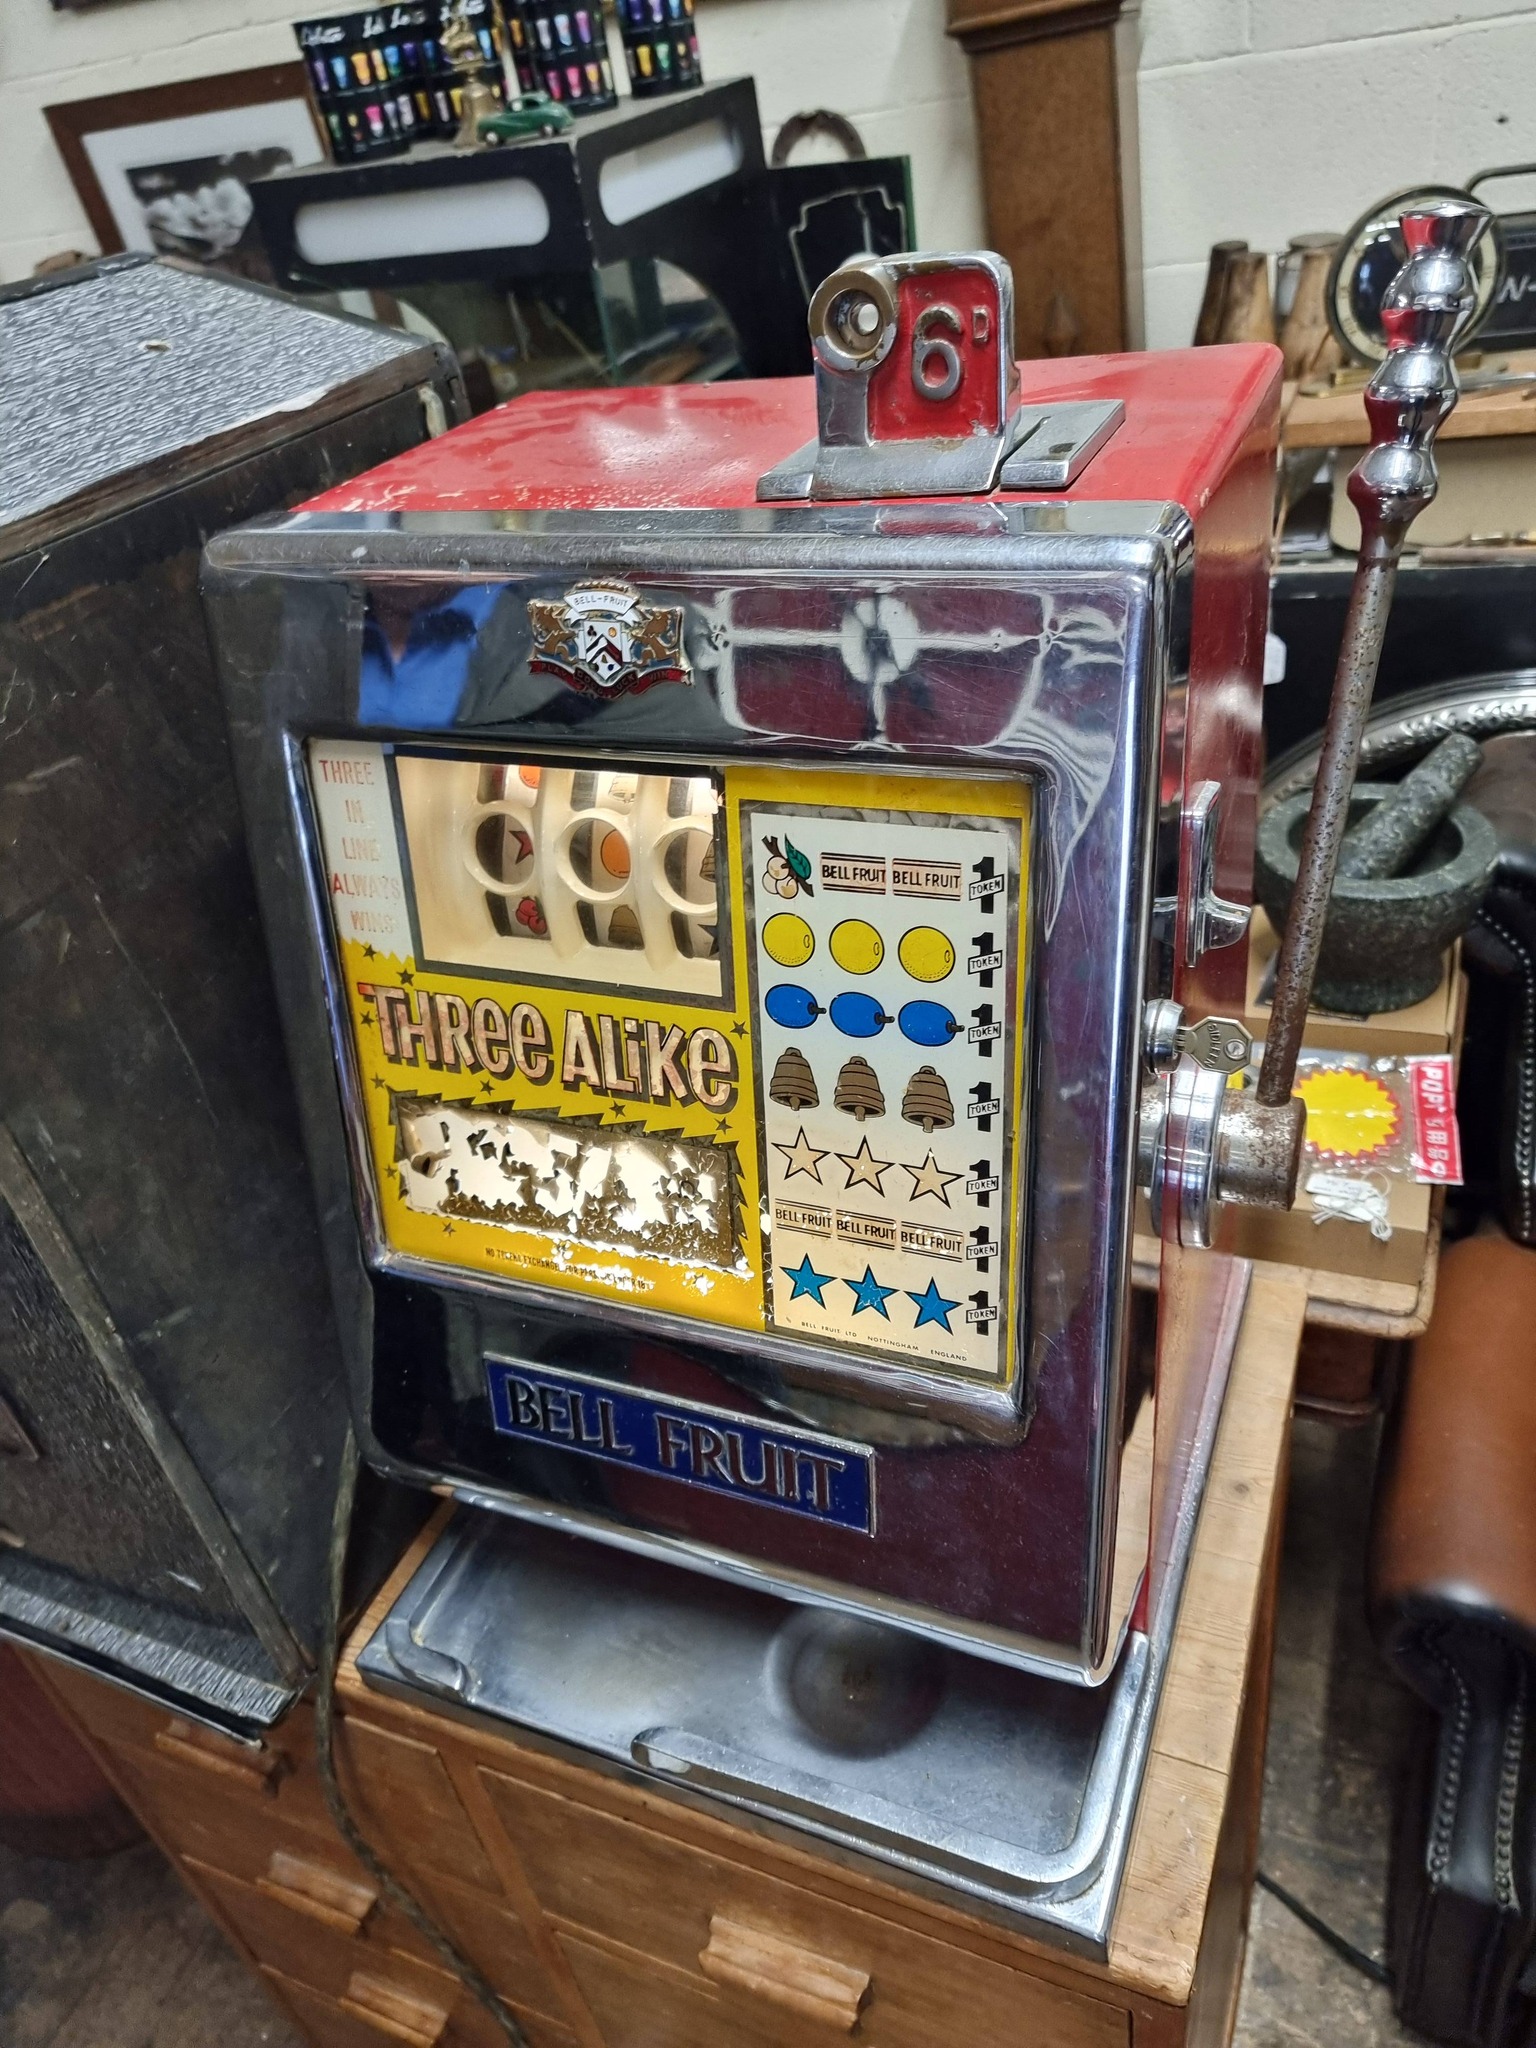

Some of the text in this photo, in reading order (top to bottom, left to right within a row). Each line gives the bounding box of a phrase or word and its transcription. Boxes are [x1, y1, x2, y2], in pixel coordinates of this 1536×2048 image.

[574, 594, 629, 608] BELL-FRUIT
[318, 760, 375, 786] THREE
[344, 799, 365, 824] IN
[341, 836, 380, 862] LINE
[822, 864, 886, 883] BELL FRUIT
[892, 869, 961, 889] BELL FRUIT
[331, 872, 400, 901] ALWAYS
[971, 880, 1001, 895] TOKEN
[350, 909, 395, 934] WINS
[970, 955, 1000, 970] TOKEN
[970, 1025, 999, 1040] TOKEN
[970, 1103, 999, 1116] TOKEN
[969, 1179, 998, 1192] TOKEN
[775, 1208, 832, 1229] BELL FRUIT
[836, 1219, 897, 1241] BELL FRUIT
[901, 1231, 962, 1253] BELL FRUIT
[968, 1245, 996, 1257] TOKEN
[968, 1308, 997, 1321] TOKEN
[821, 1326, 841, 1335] FRUIT
[845, 1330, 858, 1338] LTD
[867, 1336, 920, 1351] NOTTINGHAM
[930, 1349, 968, 1362] ENGLAND
[504, 1373, 846, 1512] BELL FRUIT
